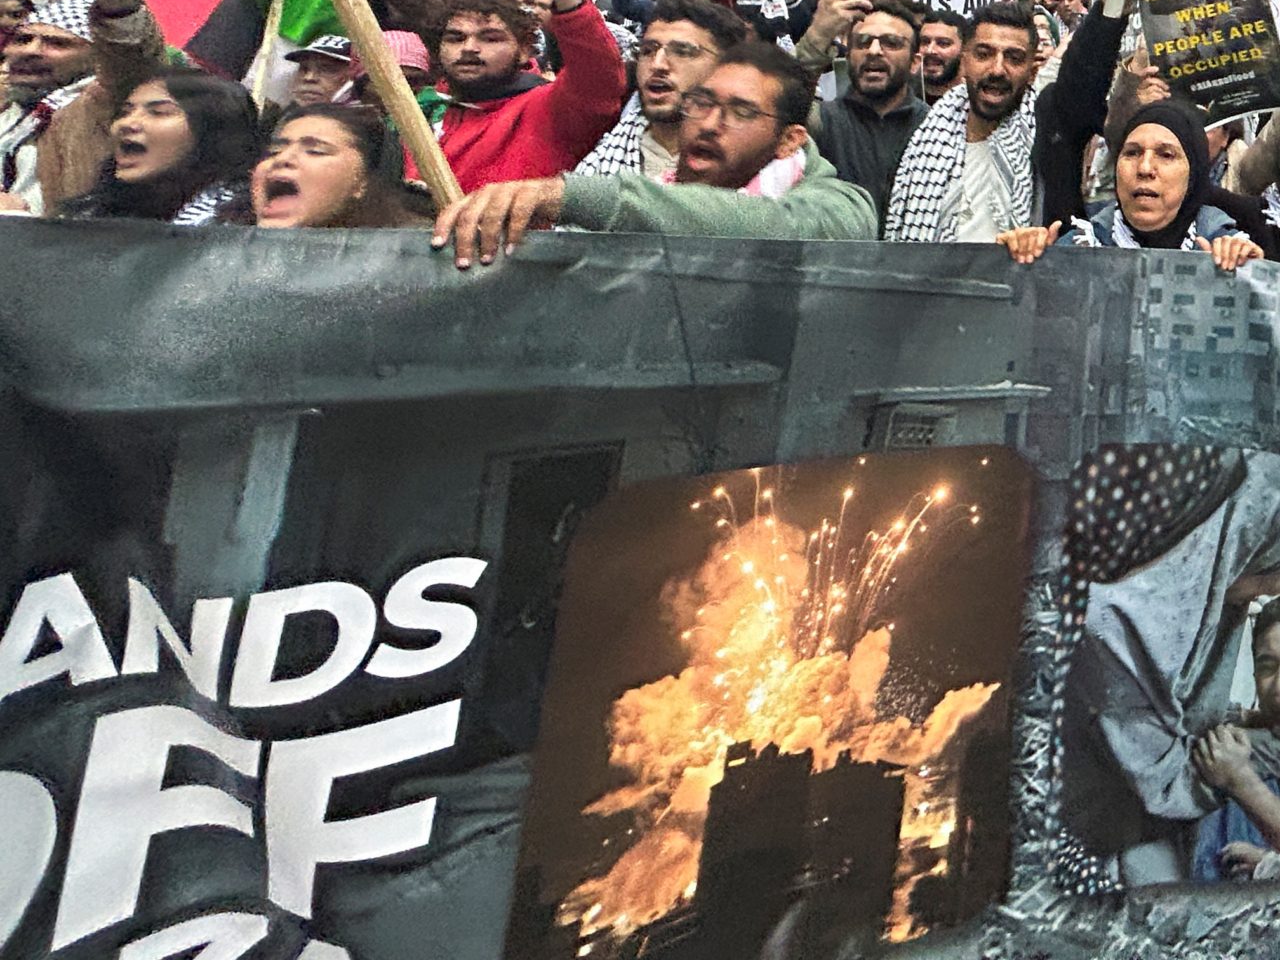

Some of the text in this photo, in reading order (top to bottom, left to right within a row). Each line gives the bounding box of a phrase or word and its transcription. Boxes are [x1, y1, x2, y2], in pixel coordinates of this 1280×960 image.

[1175, 1, 1230, 23] WHEN
[1153, 30, 1225, 56] PEOPLE
[1229, 20, 1267, 40] ARE
[1169, 48, 1263, 79] OCCUPIED
